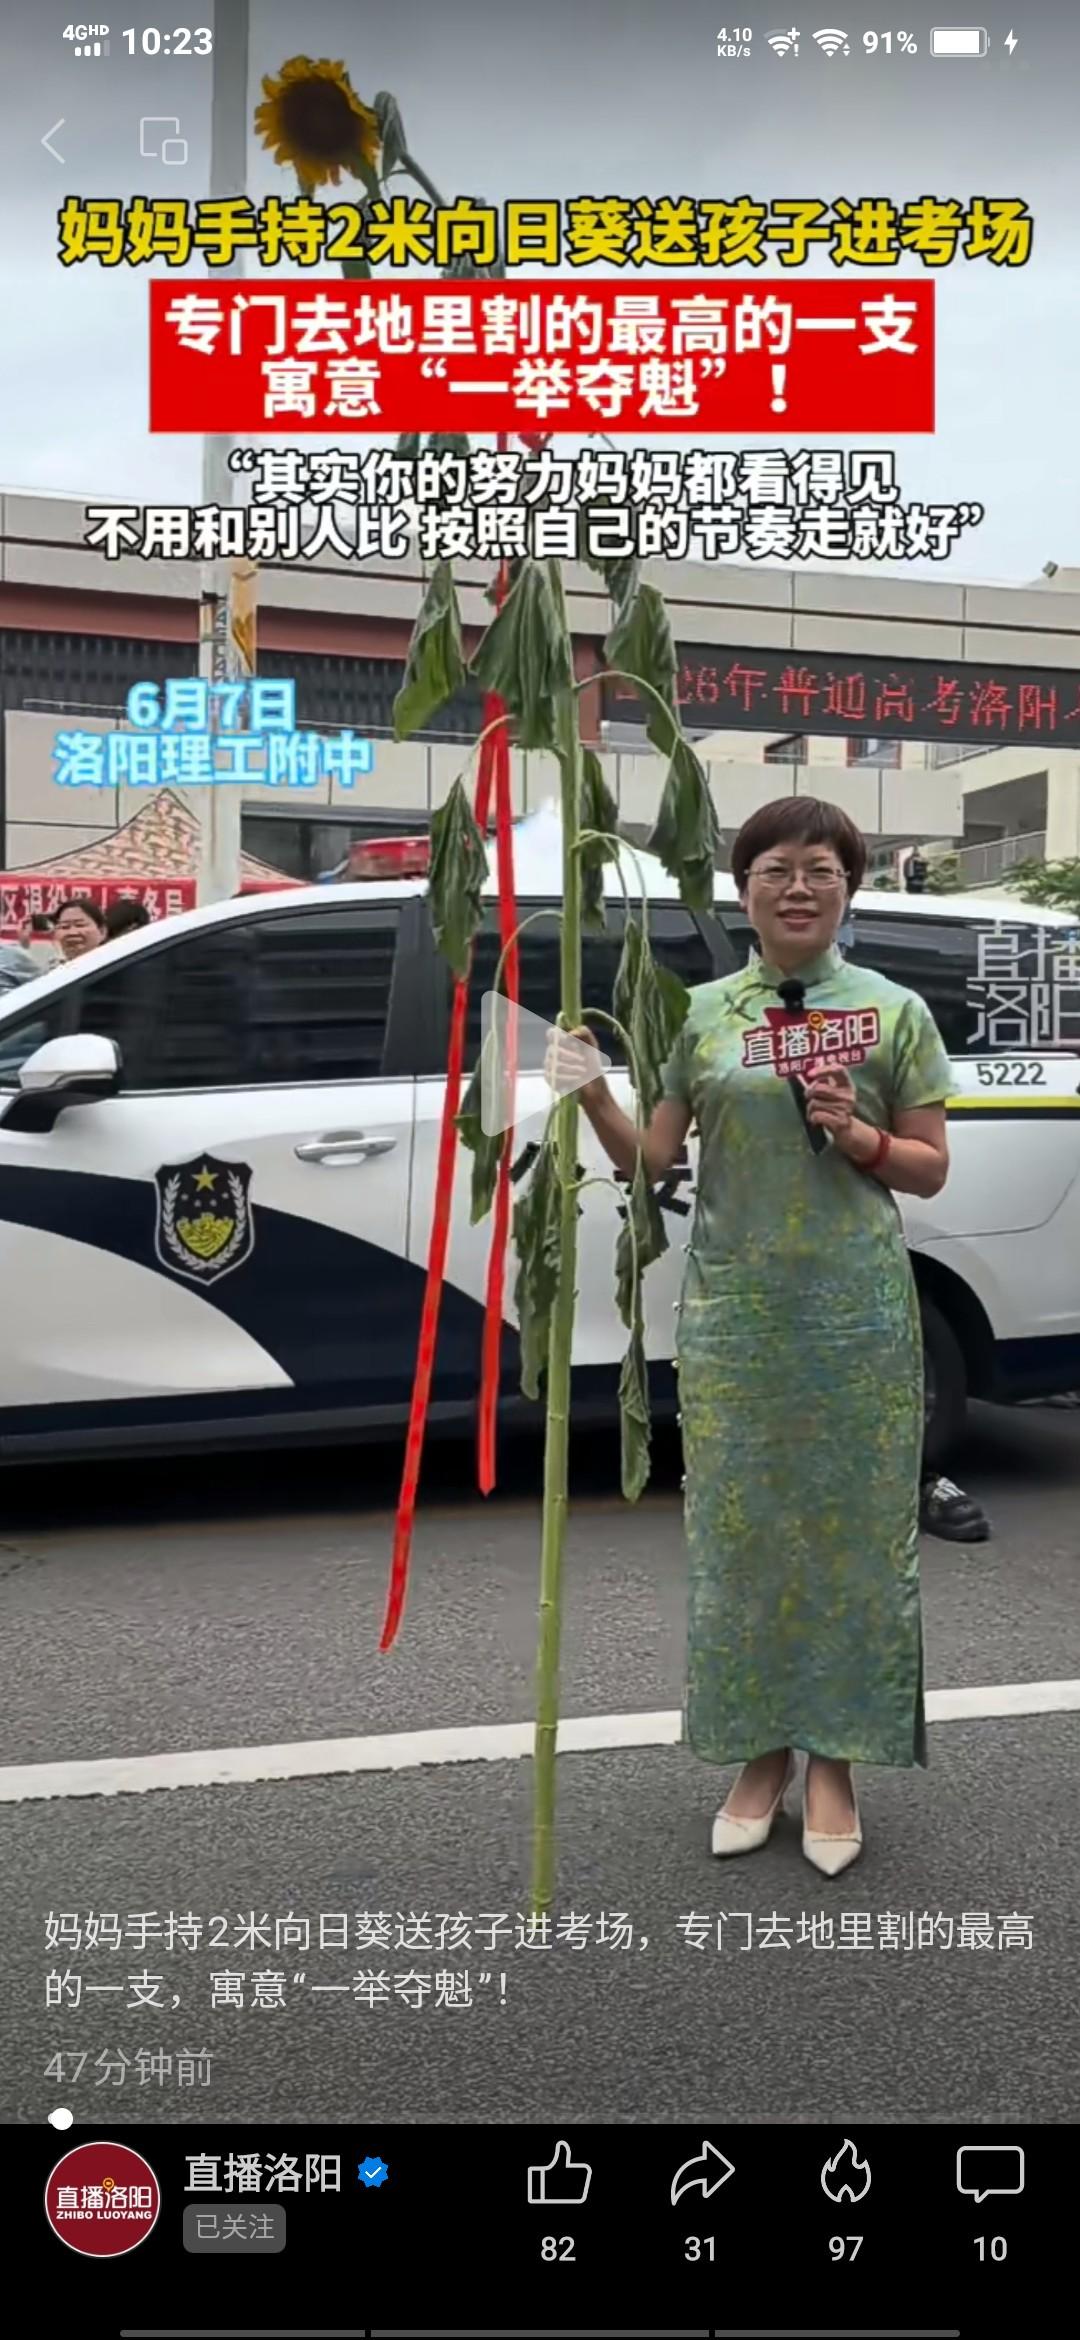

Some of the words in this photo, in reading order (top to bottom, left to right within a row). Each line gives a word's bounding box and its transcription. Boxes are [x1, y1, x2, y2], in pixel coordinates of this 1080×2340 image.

[745, 1012, 877, 1065] 直播洛阳
[976, 1062, 1047, 1086] 5222
